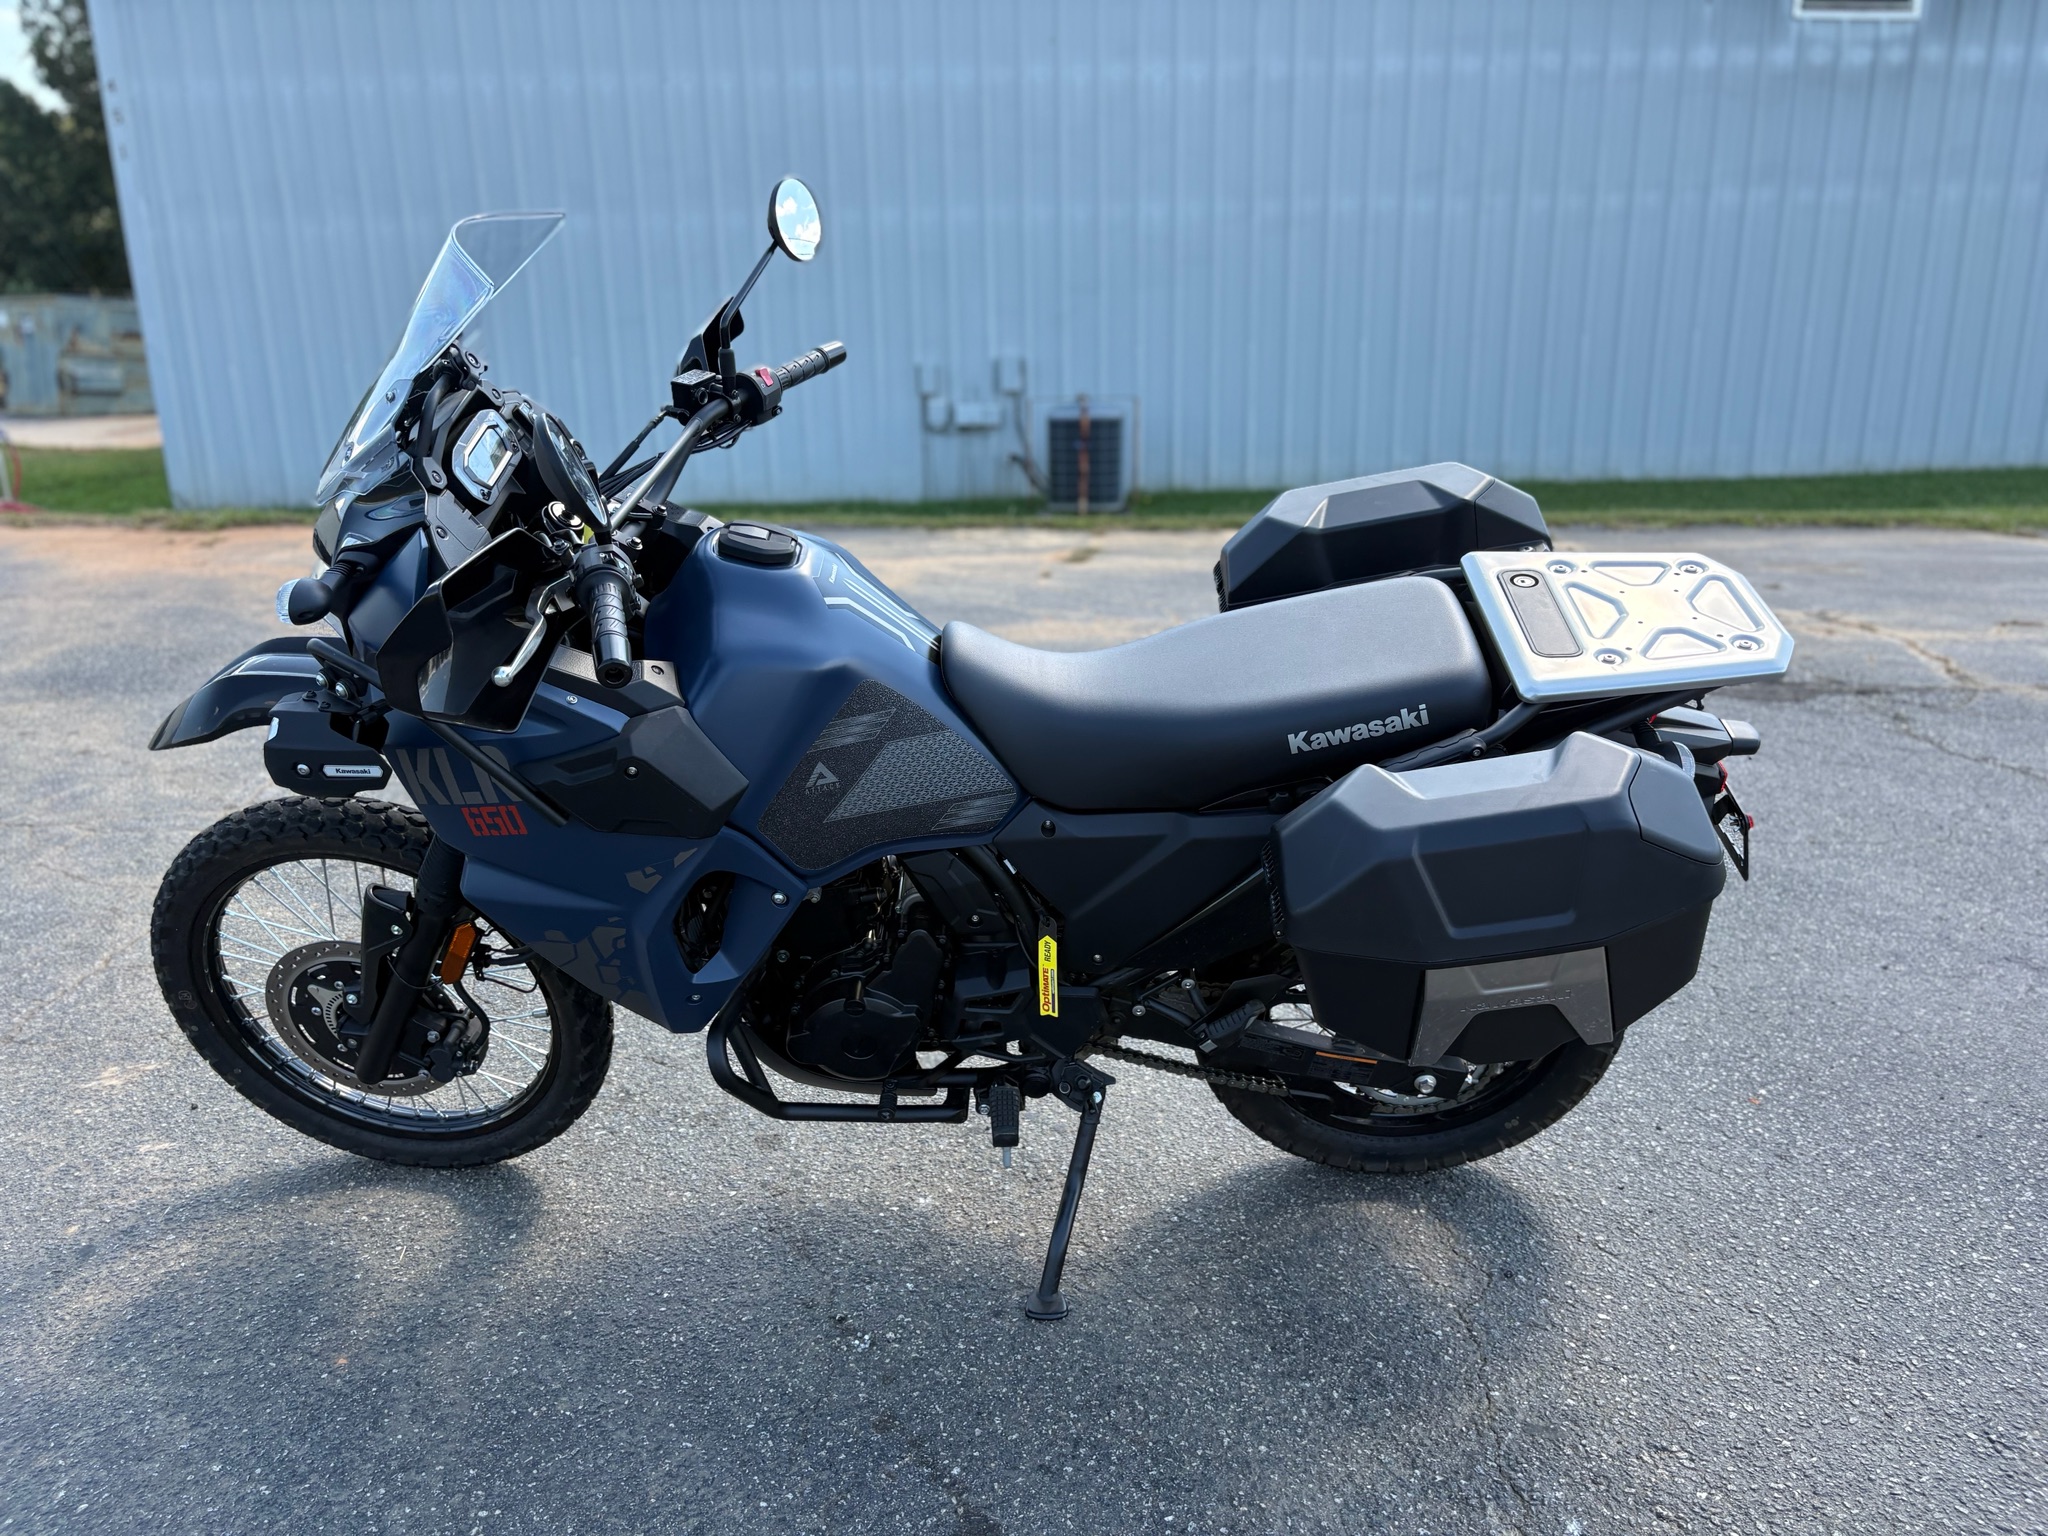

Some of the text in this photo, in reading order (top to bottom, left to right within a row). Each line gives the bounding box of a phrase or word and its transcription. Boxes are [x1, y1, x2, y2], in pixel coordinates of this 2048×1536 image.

[1287, 703, 1430, 755] Kawasaki
[335, 767, 371, 775] Kawasaki
[396, 745, 524, 805] KLR
[461, 804, 529, 837] 650
[1042, 967, 1051, 1012] OptiMATE
